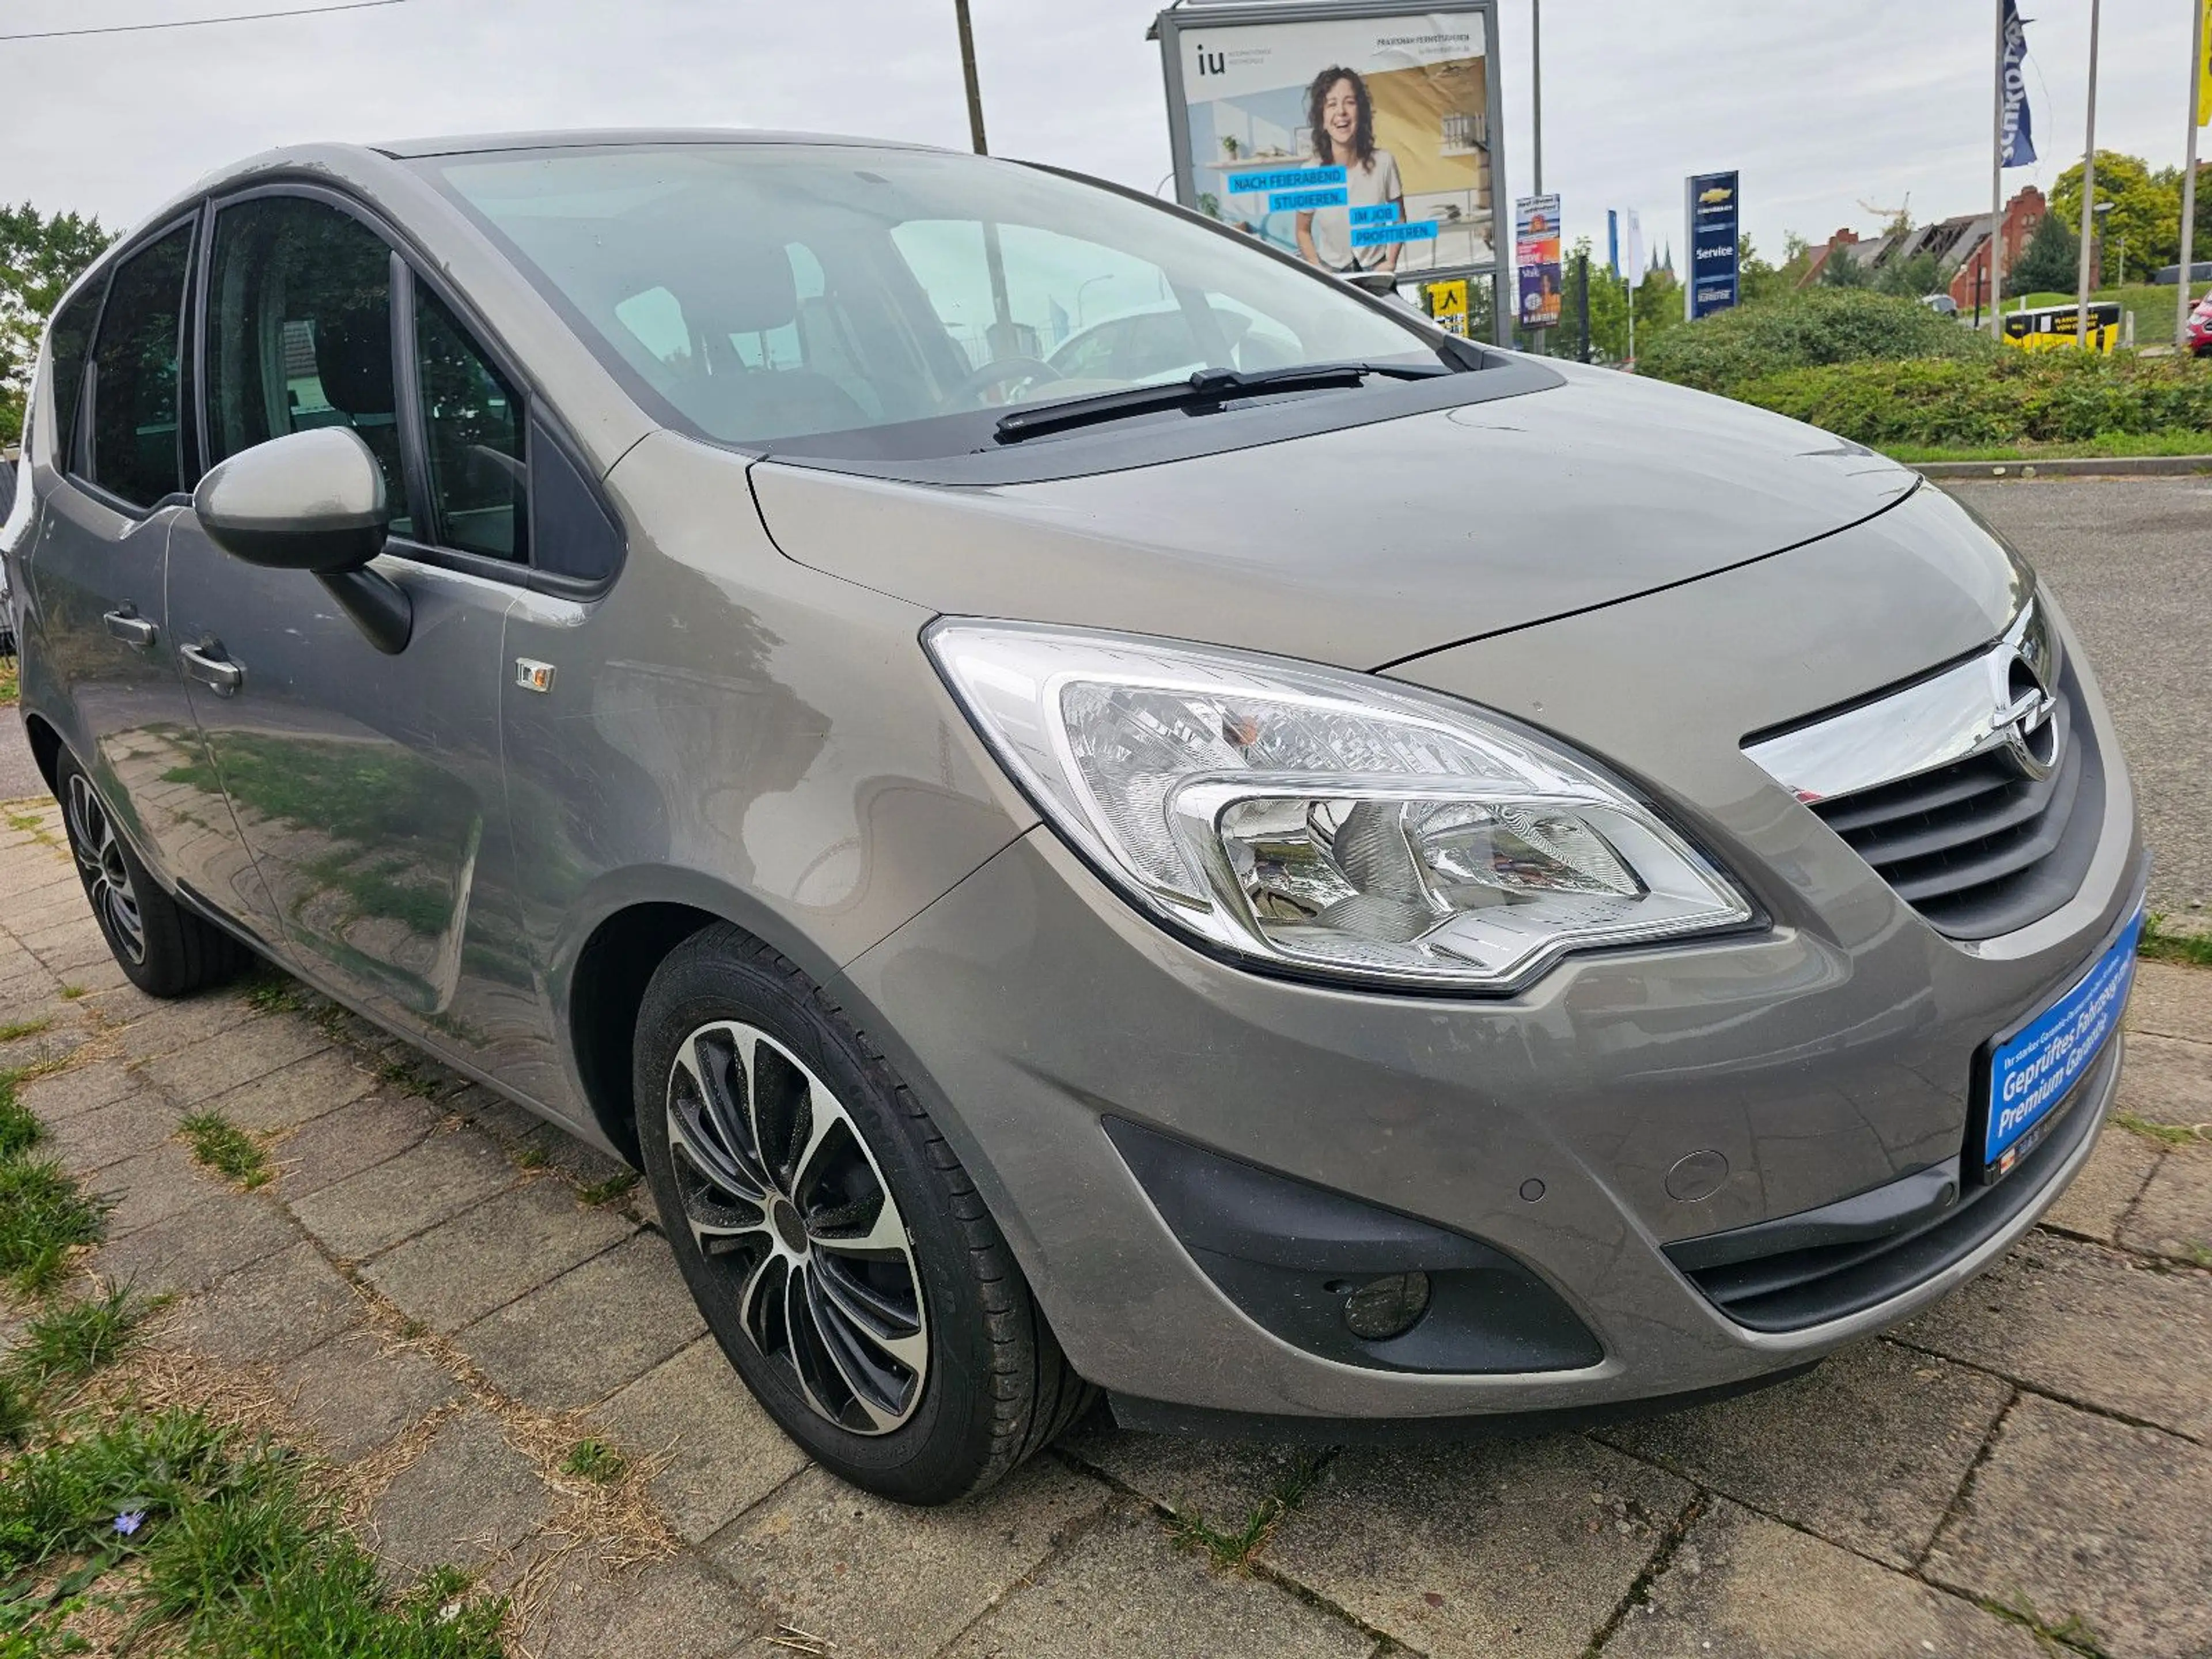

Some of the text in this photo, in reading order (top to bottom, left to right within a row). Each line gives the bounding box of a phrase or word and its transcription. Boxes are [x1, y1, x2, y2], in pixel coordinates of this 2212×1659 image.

[1197, 44, 1225, 75] iu
[1234, 169, 1340, 191] NACH FEIERABEND
[1274, 193, 1342, 210] STUDIEREN.
[1372, 208, 1393, 220] JOB
[1696, 245, 1733, 260] Service
[2003, 1028, 2075, 1101] Geprüftes
[2076, 979, 2116, 1039] Fahrzeug
[1998, 1067, 2064, 1138] Premium
